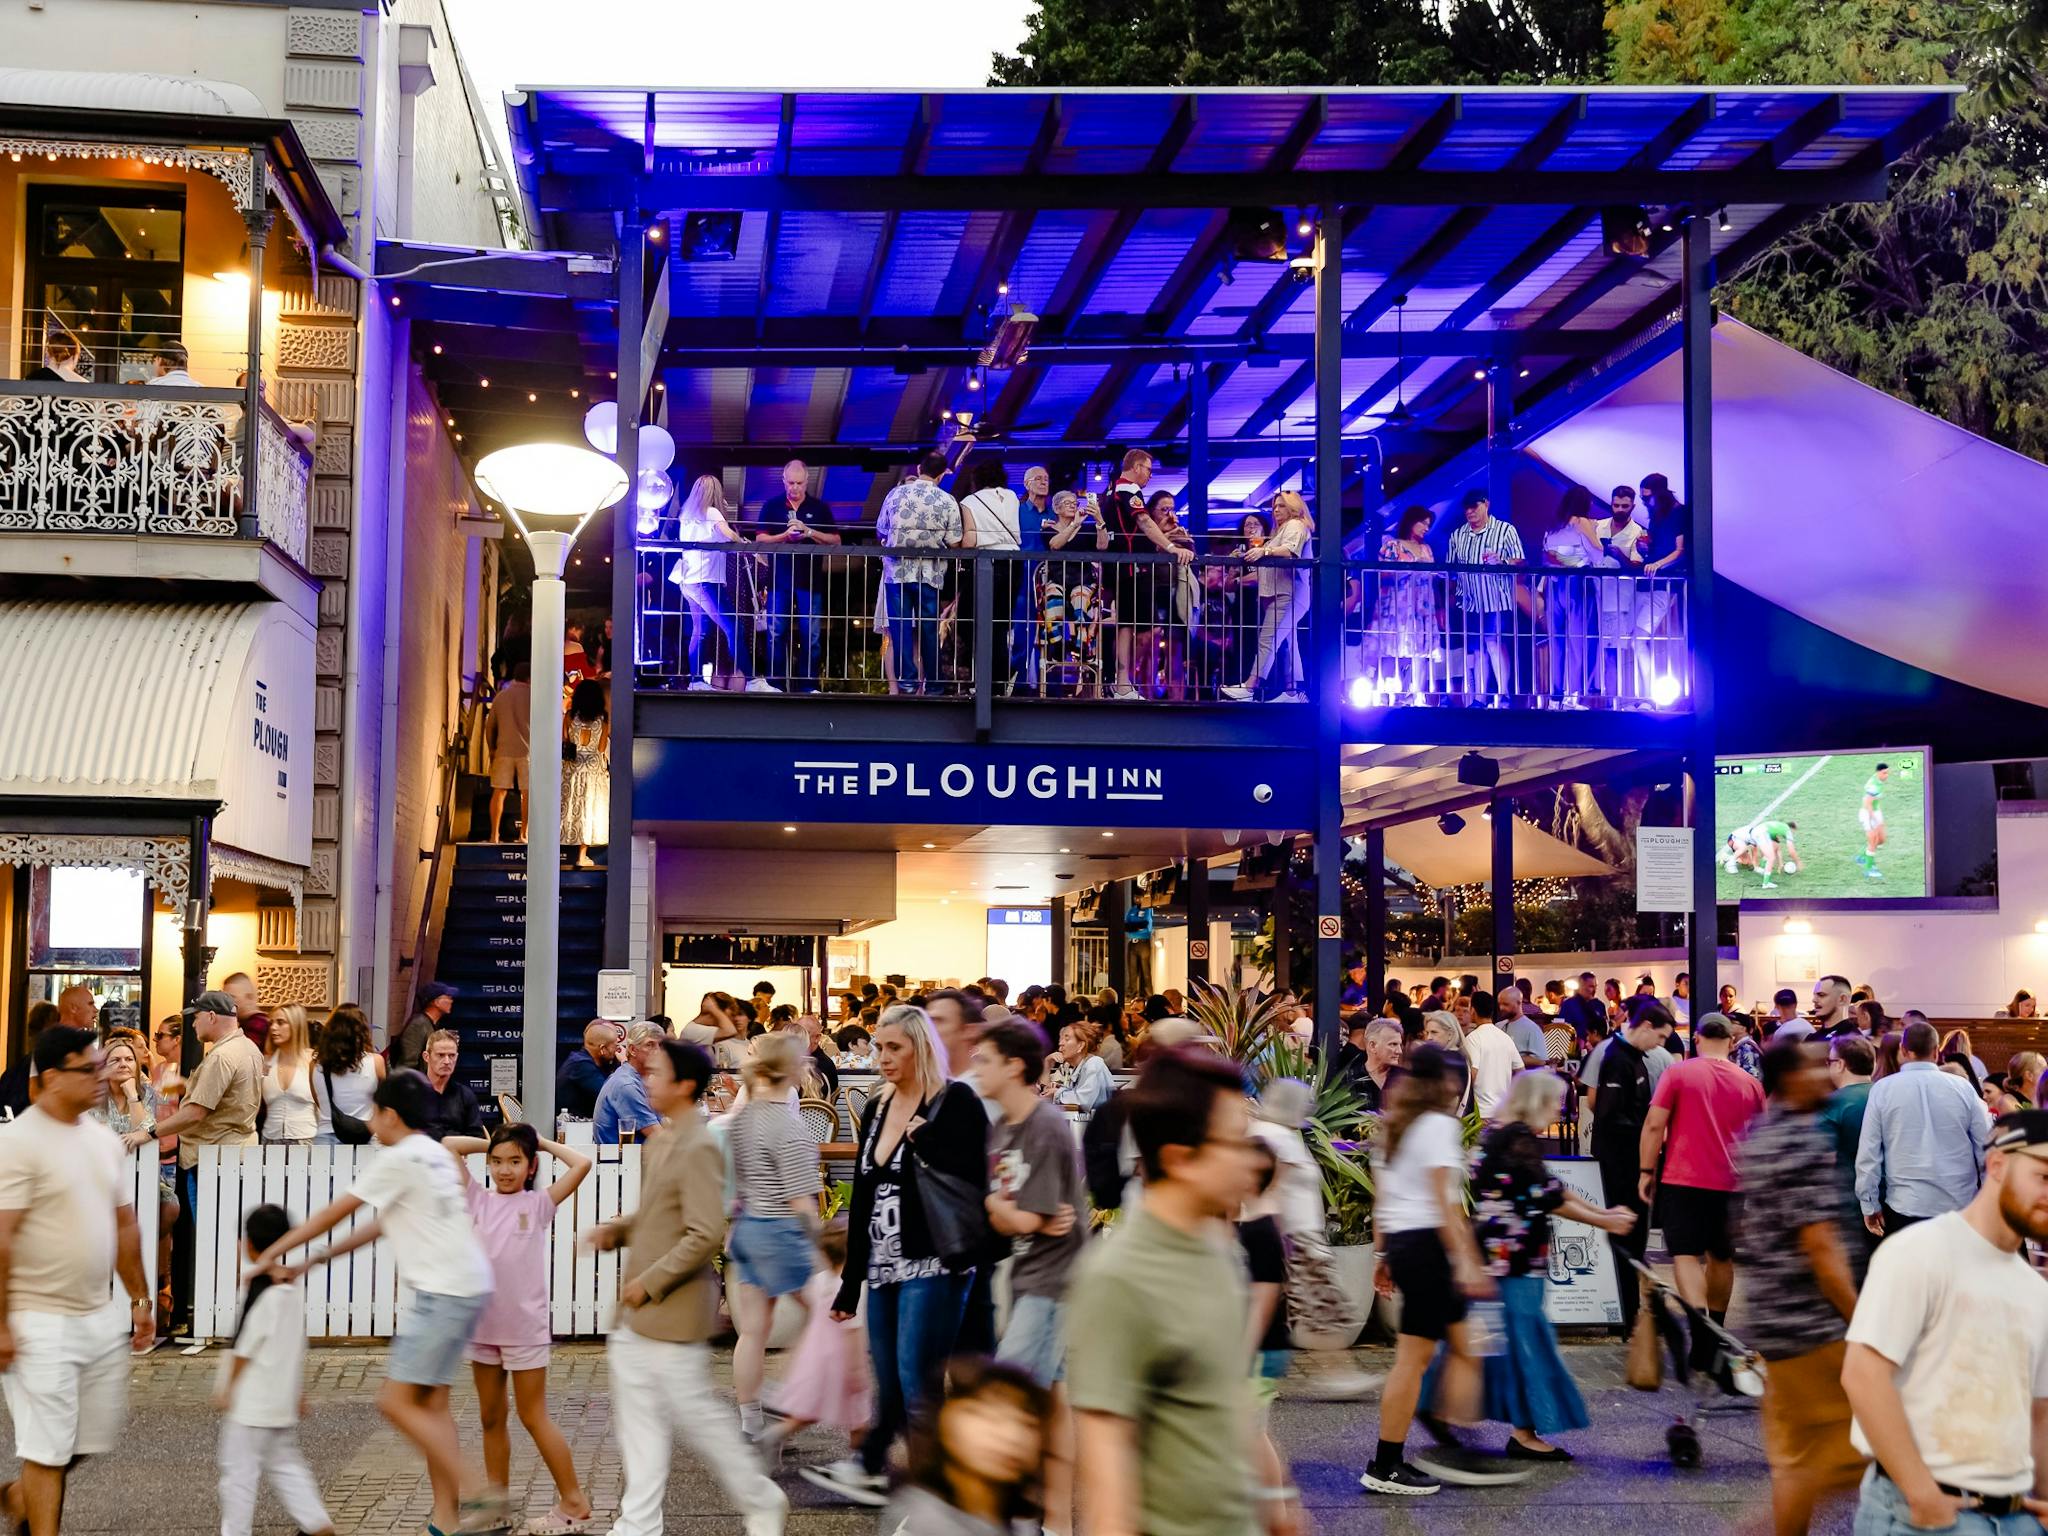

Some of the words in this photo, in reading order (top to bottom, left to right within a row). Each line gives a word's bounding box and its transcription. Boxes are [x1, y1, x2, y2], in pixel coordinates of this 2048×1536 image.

[255, 691, 267, 713] THE
[253, 717, 289, 763] PLOUGH
[794, 773, 859, 795] THE
[869, 761, 1097, 800] PLOUGH
[1107, 767, 1162, 788] INN
[503, 938, 526, 946] PLO
